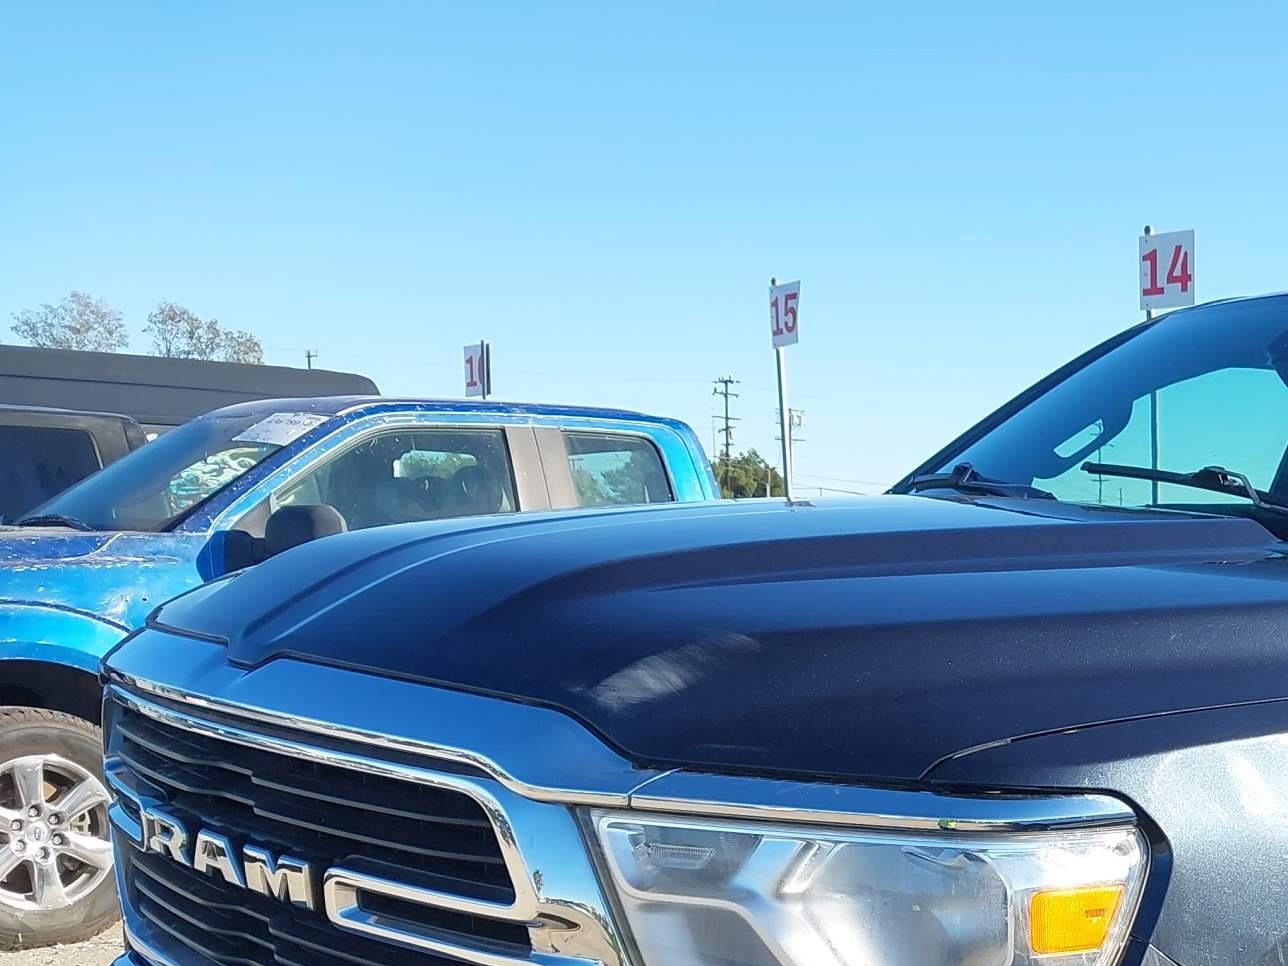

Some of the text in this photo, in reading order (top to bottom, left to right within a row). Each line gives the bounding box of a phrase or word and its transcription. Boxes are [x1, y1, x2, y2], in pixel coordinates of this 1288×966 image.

[1141, 244, 1193, 297] 14
[771, 292, 798, 336] 15
[465, 354, 485, 388] 1
[144, 804, 315, 911] RAM
